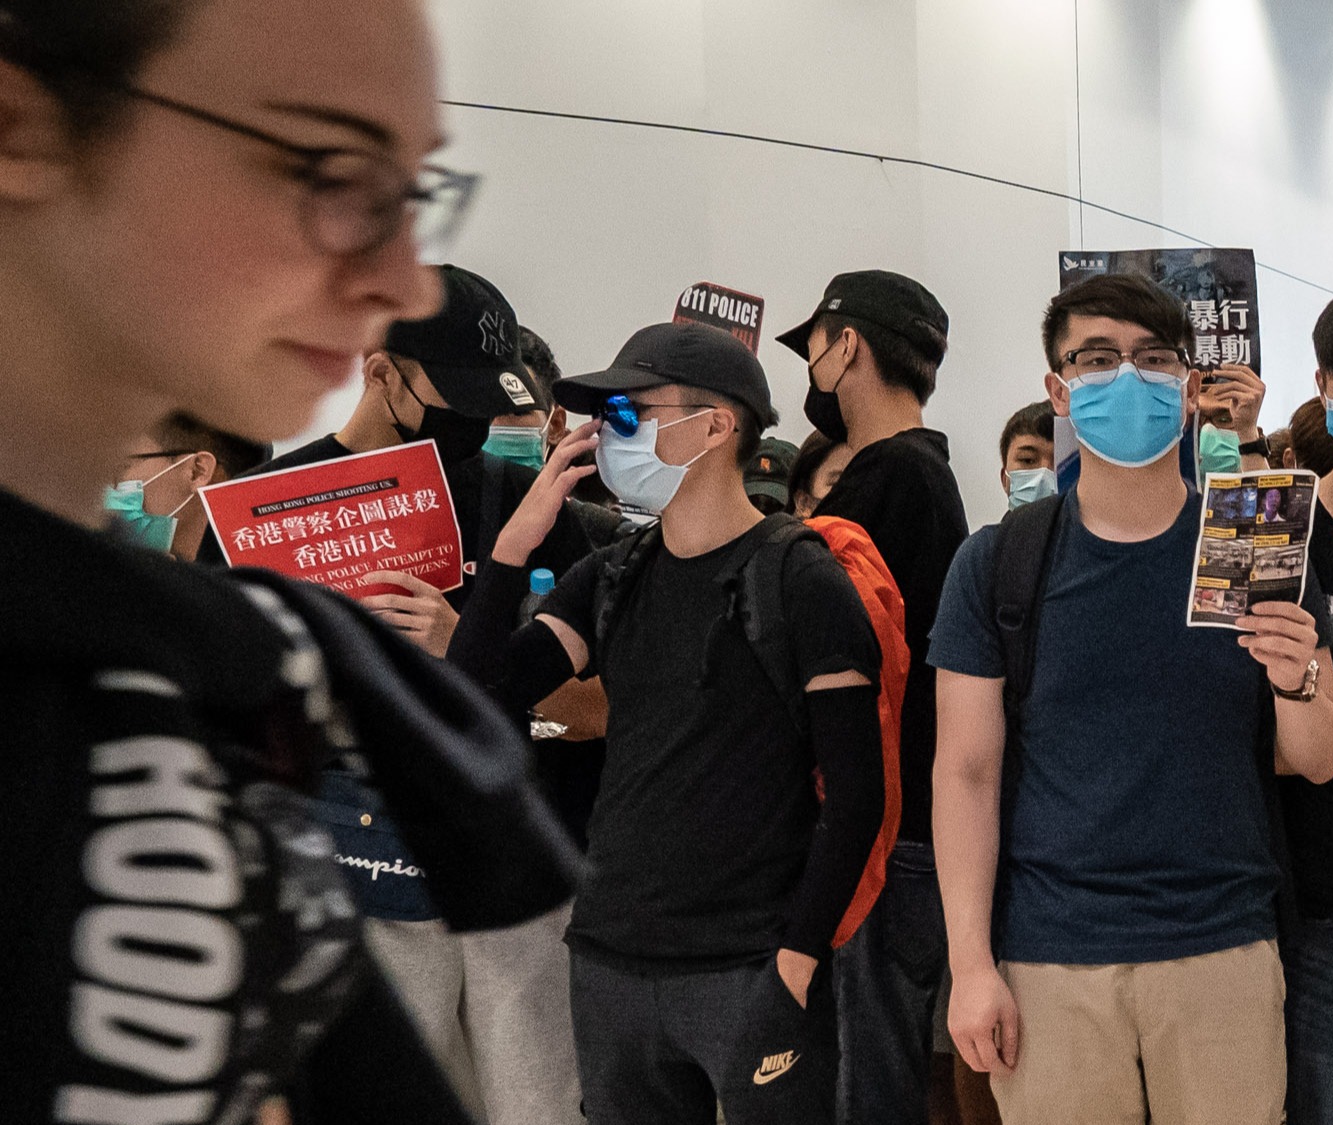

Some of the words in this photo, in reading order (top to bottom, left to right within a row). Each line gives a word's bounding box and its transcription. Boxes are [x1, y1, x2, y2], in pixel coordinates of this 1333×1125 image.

[680, 286, 707, 313] 811
[708, 293, 760, 329] POLICE
[1190, 299, 1250, 331] 暴行
[1194, 334, 1251, 366] 暴動
[257, 501, 283, 515] HONG
[282, 497, 306, 511] KONG
[306, 491, 335, 505] POLICE
[335, 483, 379, 499] SHOOTING
[231, 488, 441, 552] 香港警察企圖謀殺
[293, 527, 397, 569] 香港市民
[327, 561, 371, 582] POLICE
[376, 548, 435, 570] ATTEMPT
[436, 543, 453, 555] TO
[760, 1049, 795, 1074] NIKE
